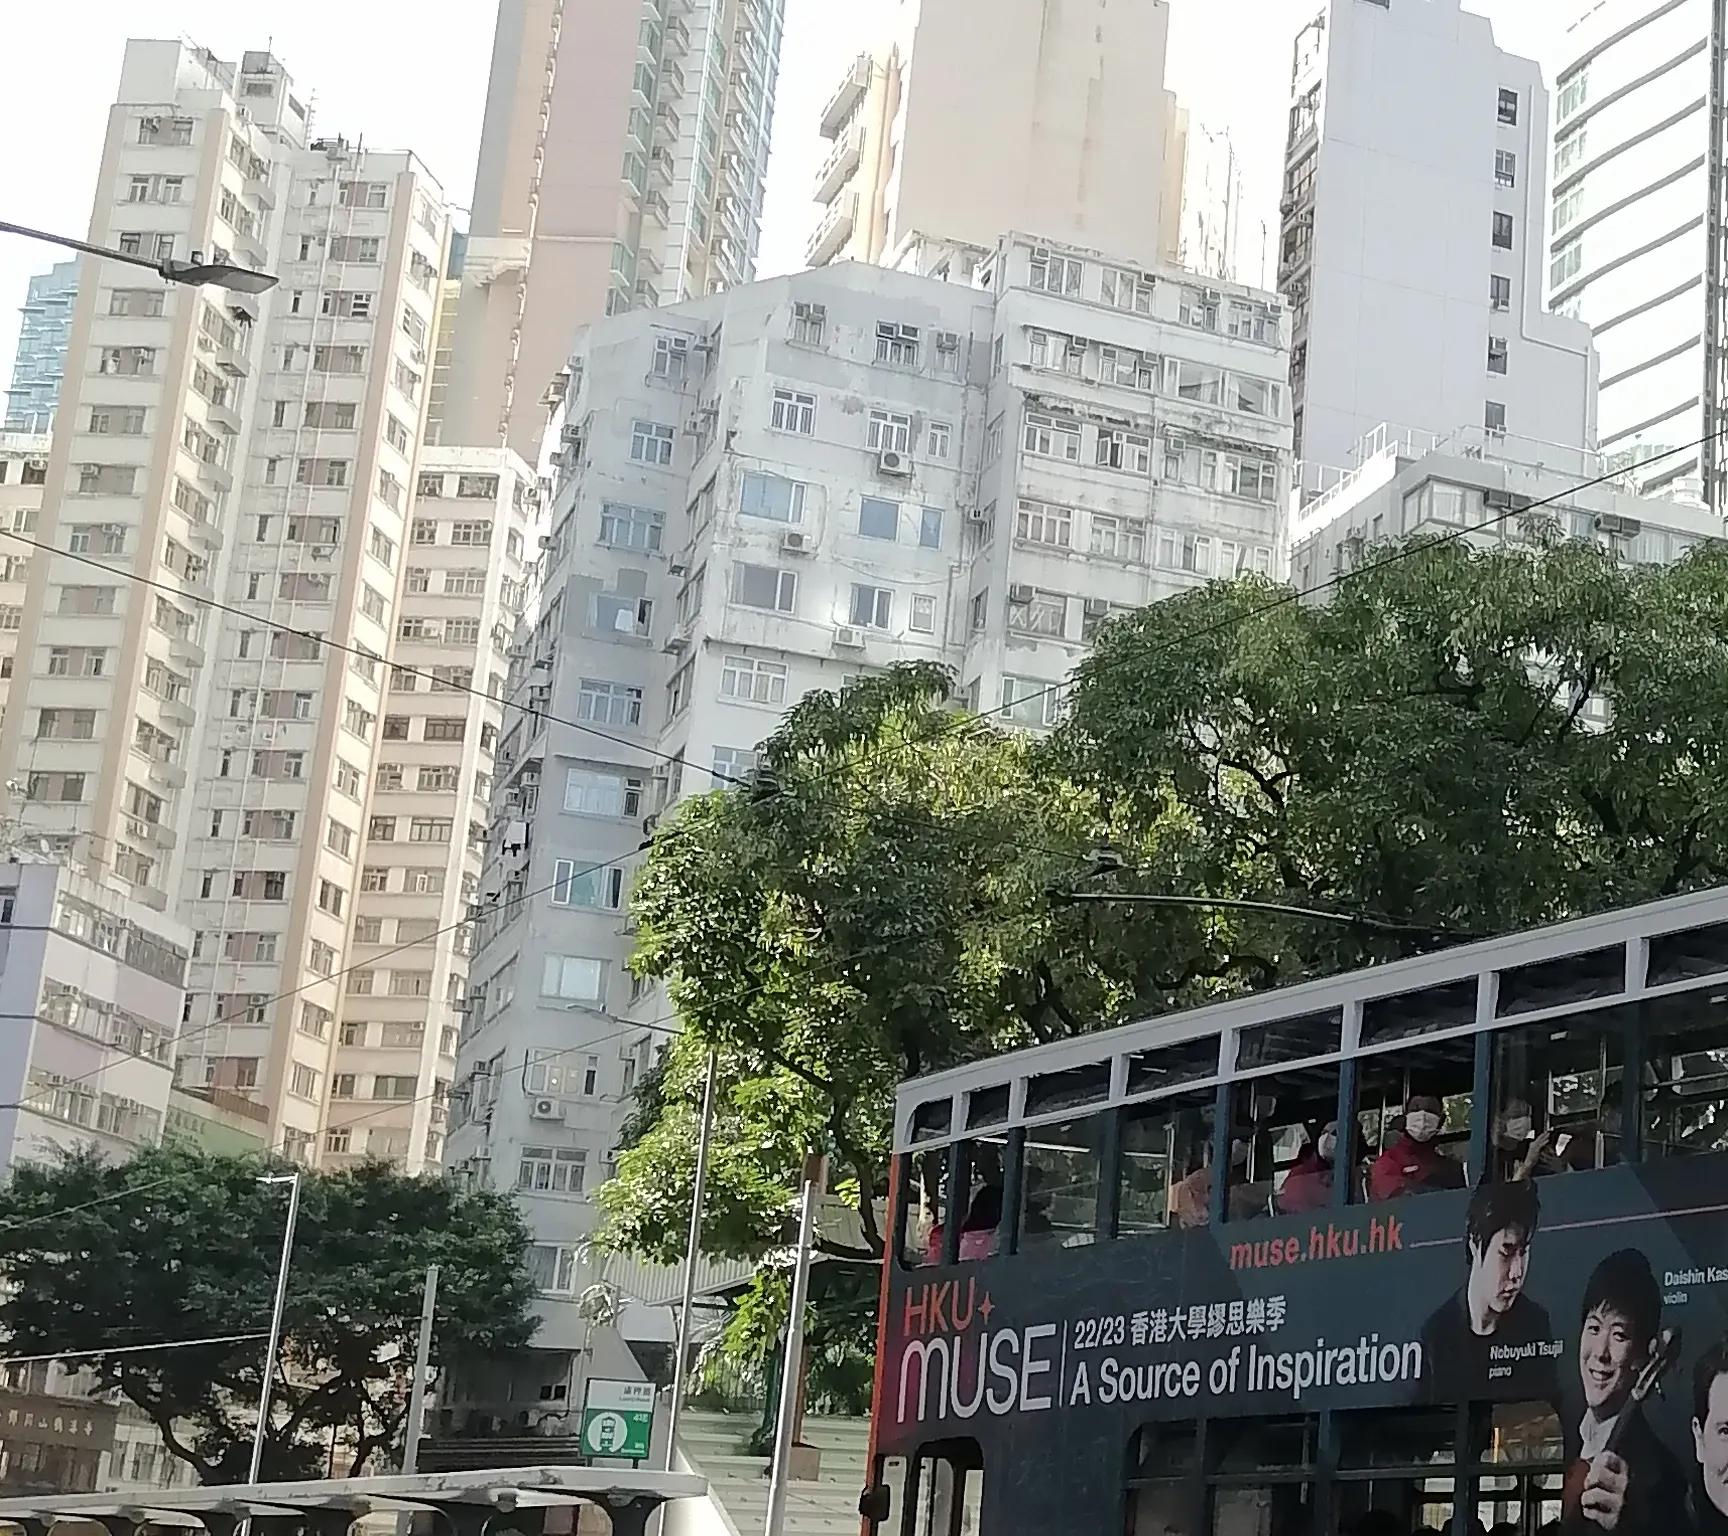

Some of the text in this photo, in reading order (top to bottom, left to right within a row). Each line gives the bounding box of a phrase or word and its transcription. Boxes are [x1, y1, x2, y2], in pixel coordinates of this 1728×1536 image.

[1230, 1214, 1404, 1270] muse.hku.hk
[1664, 1269, 1705, 1286] Daishin
[904, 1276, 976, 1337] HKU
[1074, 1295, 1288, 1349] 22/23 香港大學繆思樂季
[1070, 1332, 1423, 1406] A Source of Inspiration
[1488, 1364, 1512, 1379] piano
[1490, 1342, 1536, 1361] Nobuyuki
